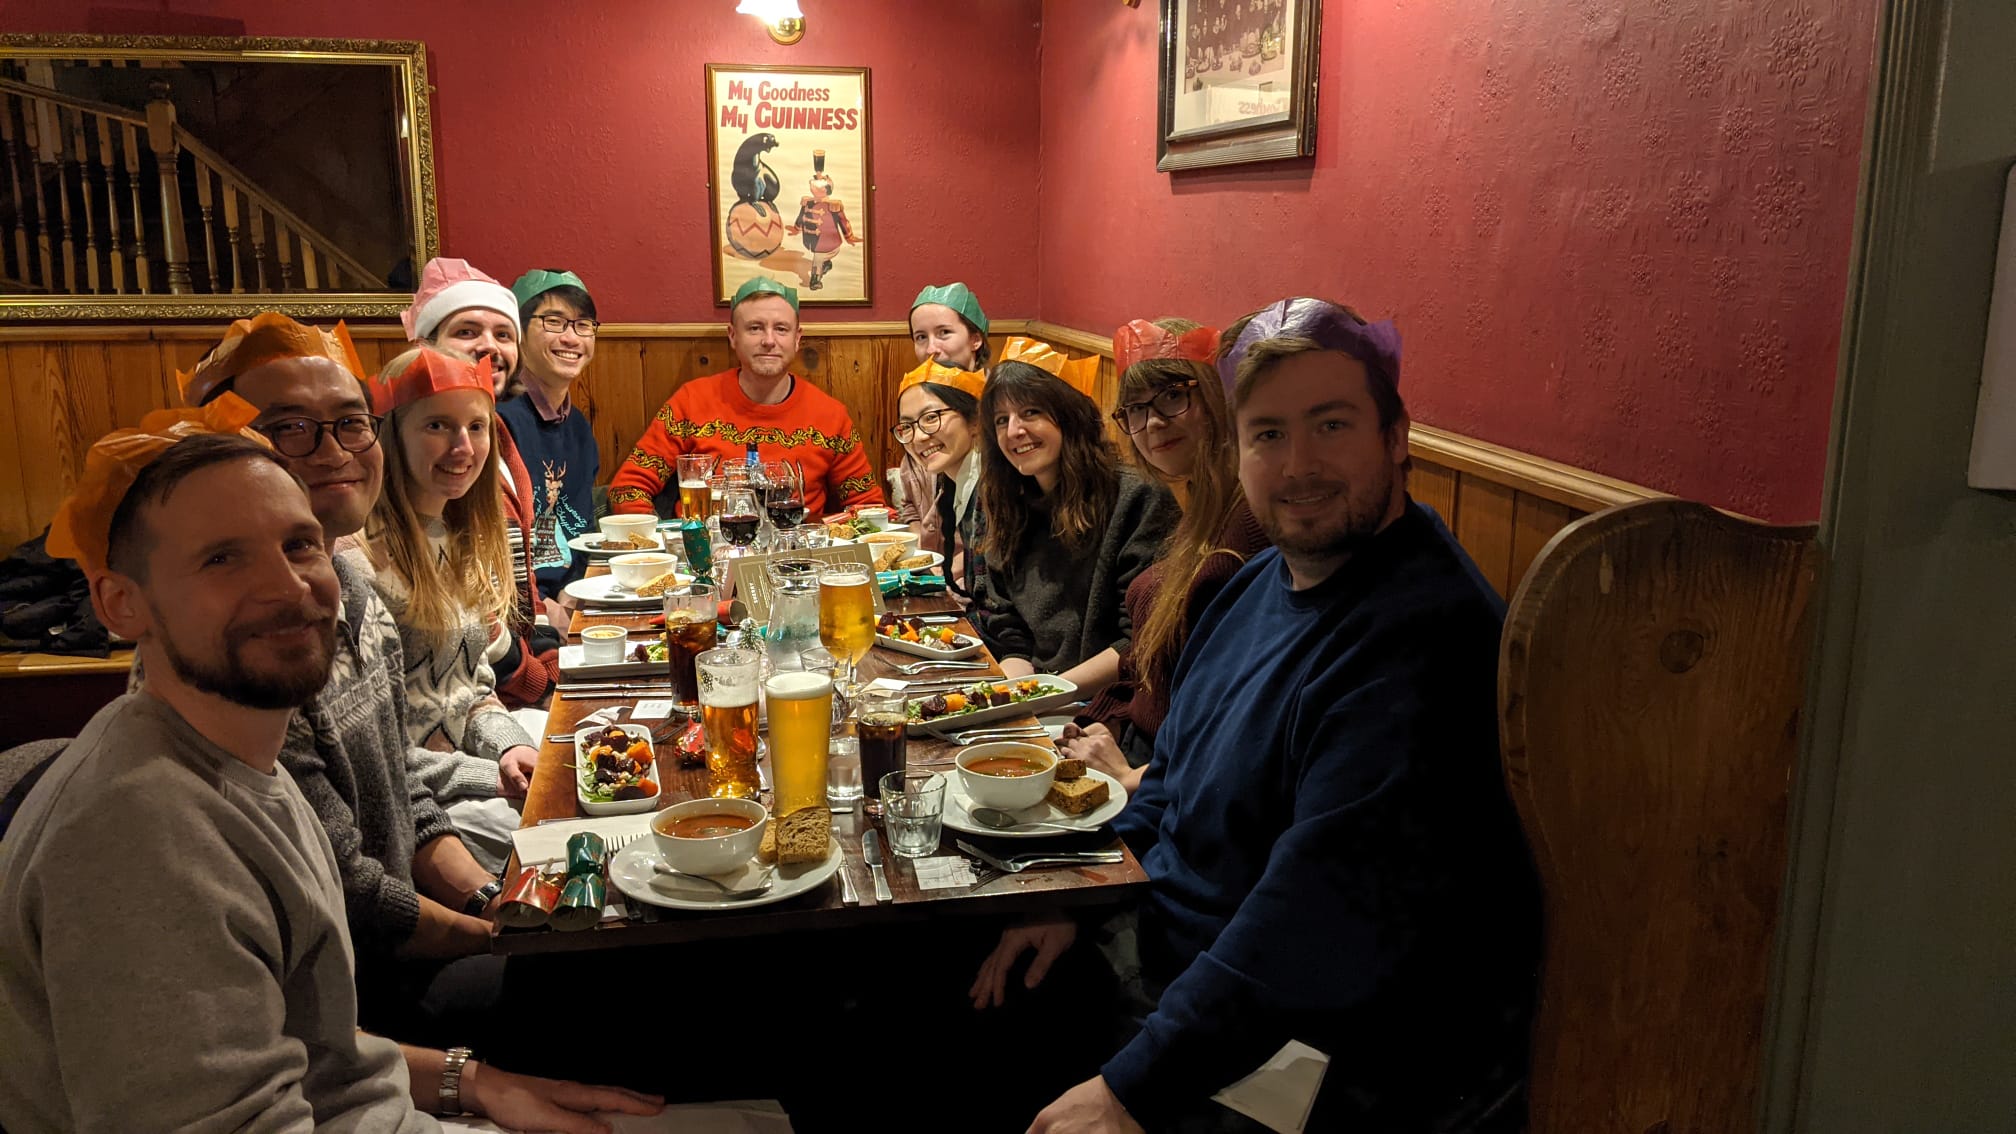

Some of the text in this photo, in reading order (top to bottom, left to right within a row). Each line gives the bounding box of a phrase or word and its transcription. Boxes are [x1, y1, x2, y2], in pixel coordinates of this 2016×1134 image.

[728, 80, 830, 105] My Goodness
[721, 101, 858, 134] My GUINNESS
